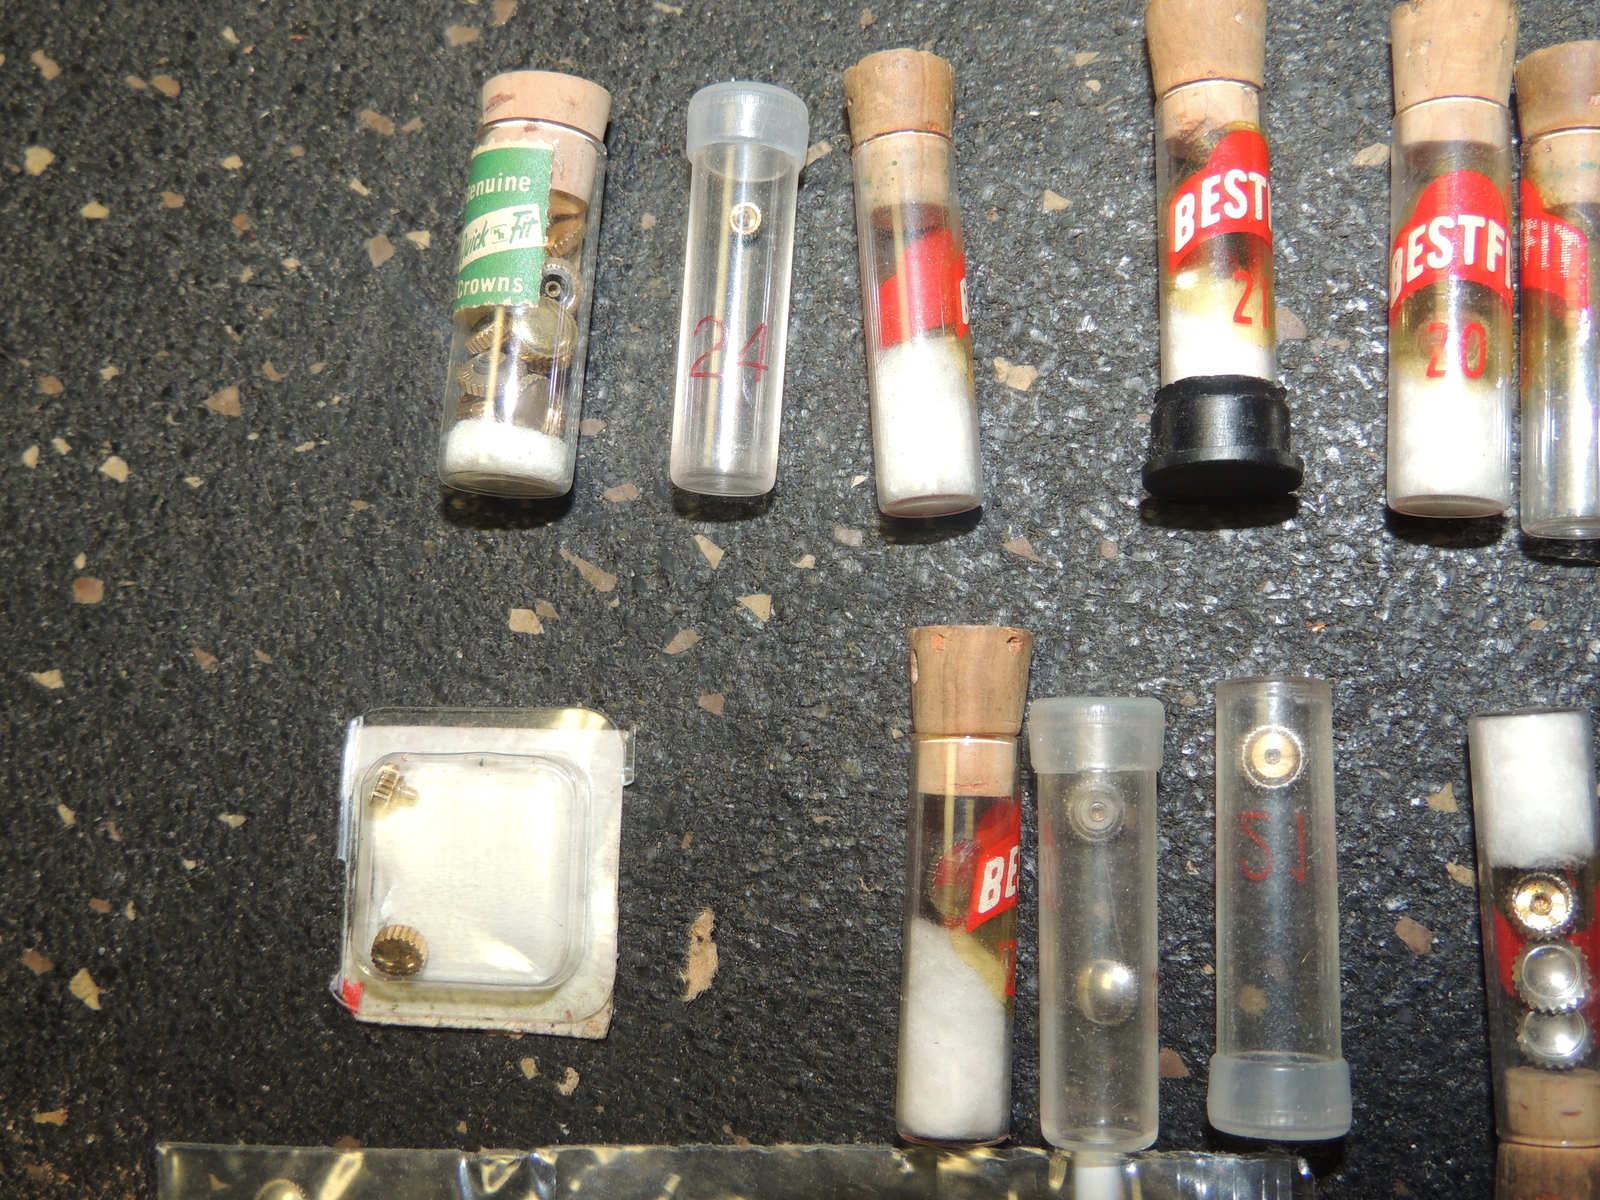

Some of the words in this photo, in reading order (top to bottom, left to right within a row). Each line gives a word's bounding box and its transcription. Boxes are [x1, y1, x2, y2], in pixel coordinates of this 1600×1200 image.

[509, 210, 538, 244] Fit
[1174, 168, 1272, 253] BEST
[1233, 269, 1269, 329] 21
[690, 315, 770, 382] 24
[1425, 321, 1487, 380] 20
[978, 845, 1020, 914] BE
